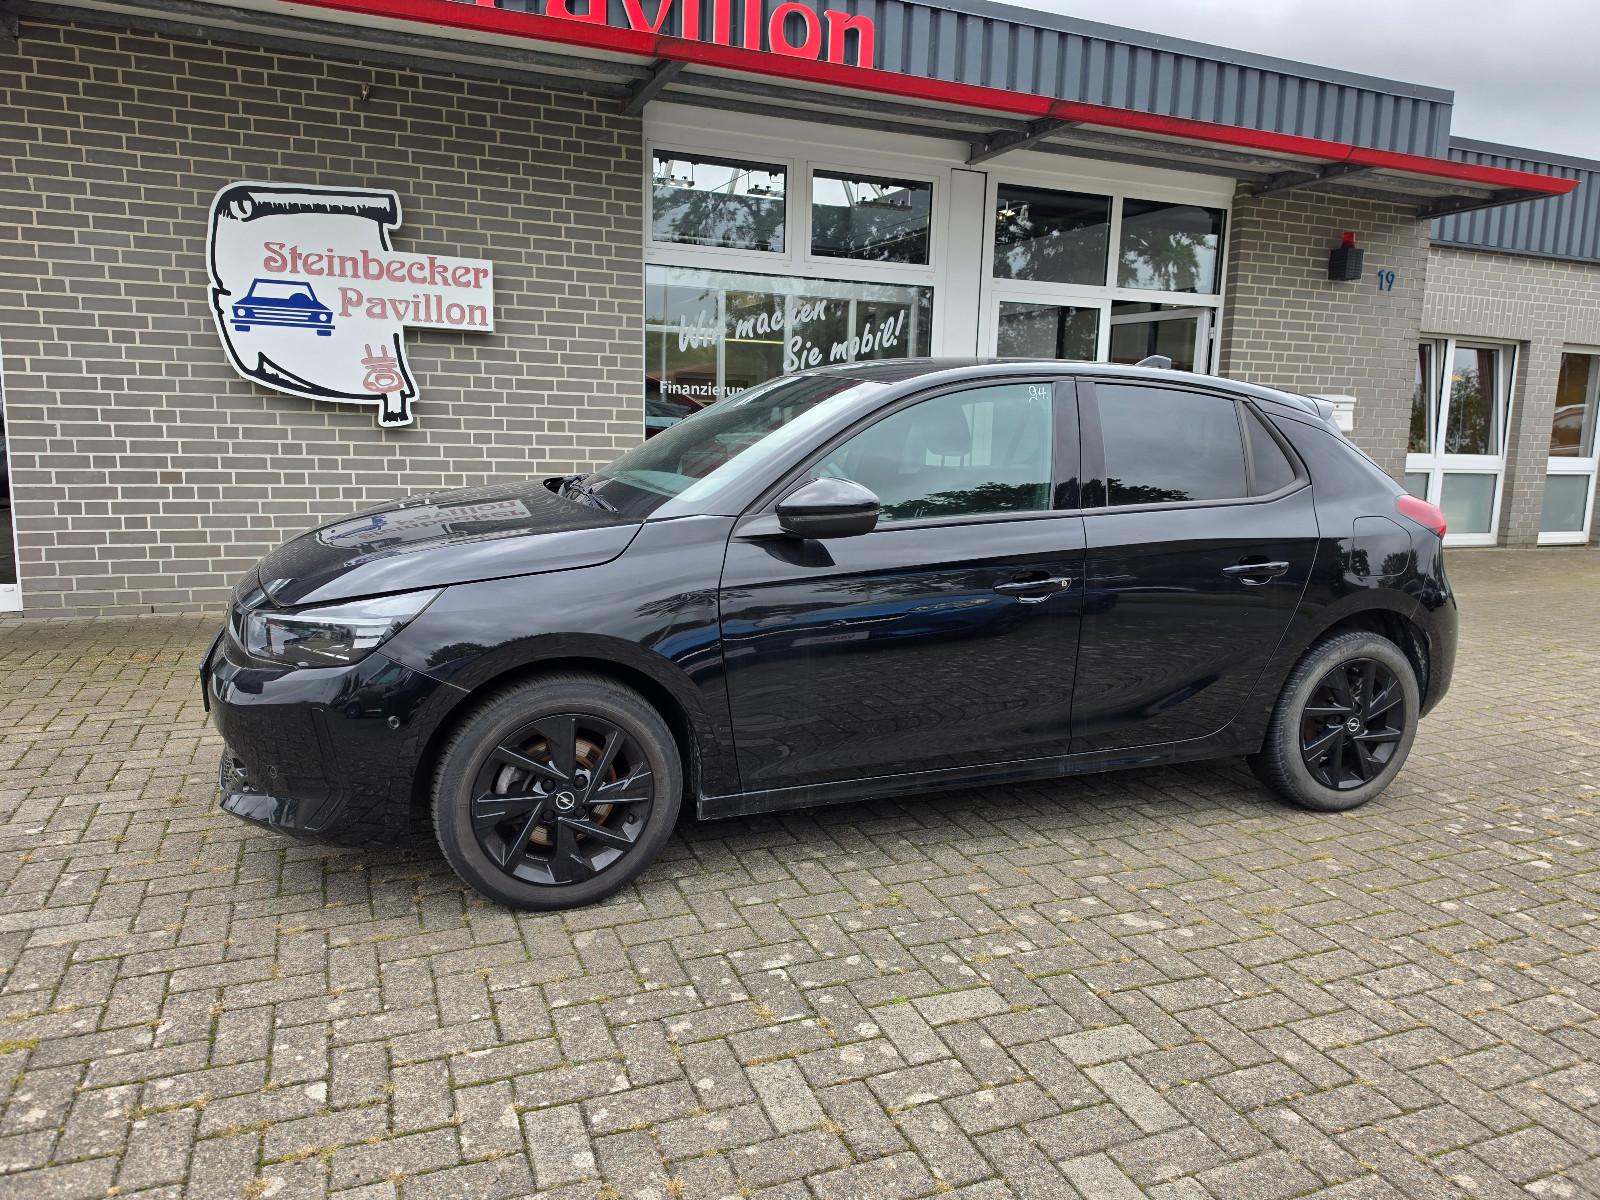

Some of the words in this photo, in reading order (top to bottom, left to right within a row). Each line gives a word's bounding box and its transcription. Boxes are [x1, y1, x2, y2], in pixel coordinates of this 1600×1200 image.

[263, 241, 489, 289] Steinbecker
[1378, 269, 1395, 292] 19
[338, 287, 489, 327] Pavillon
[679, 309, 727, 352] Wir
[783, 335, 822, 372] Sie
[830, 310, 905, 362] mobil!
[659, 380, 746, 396] Finanzierun
